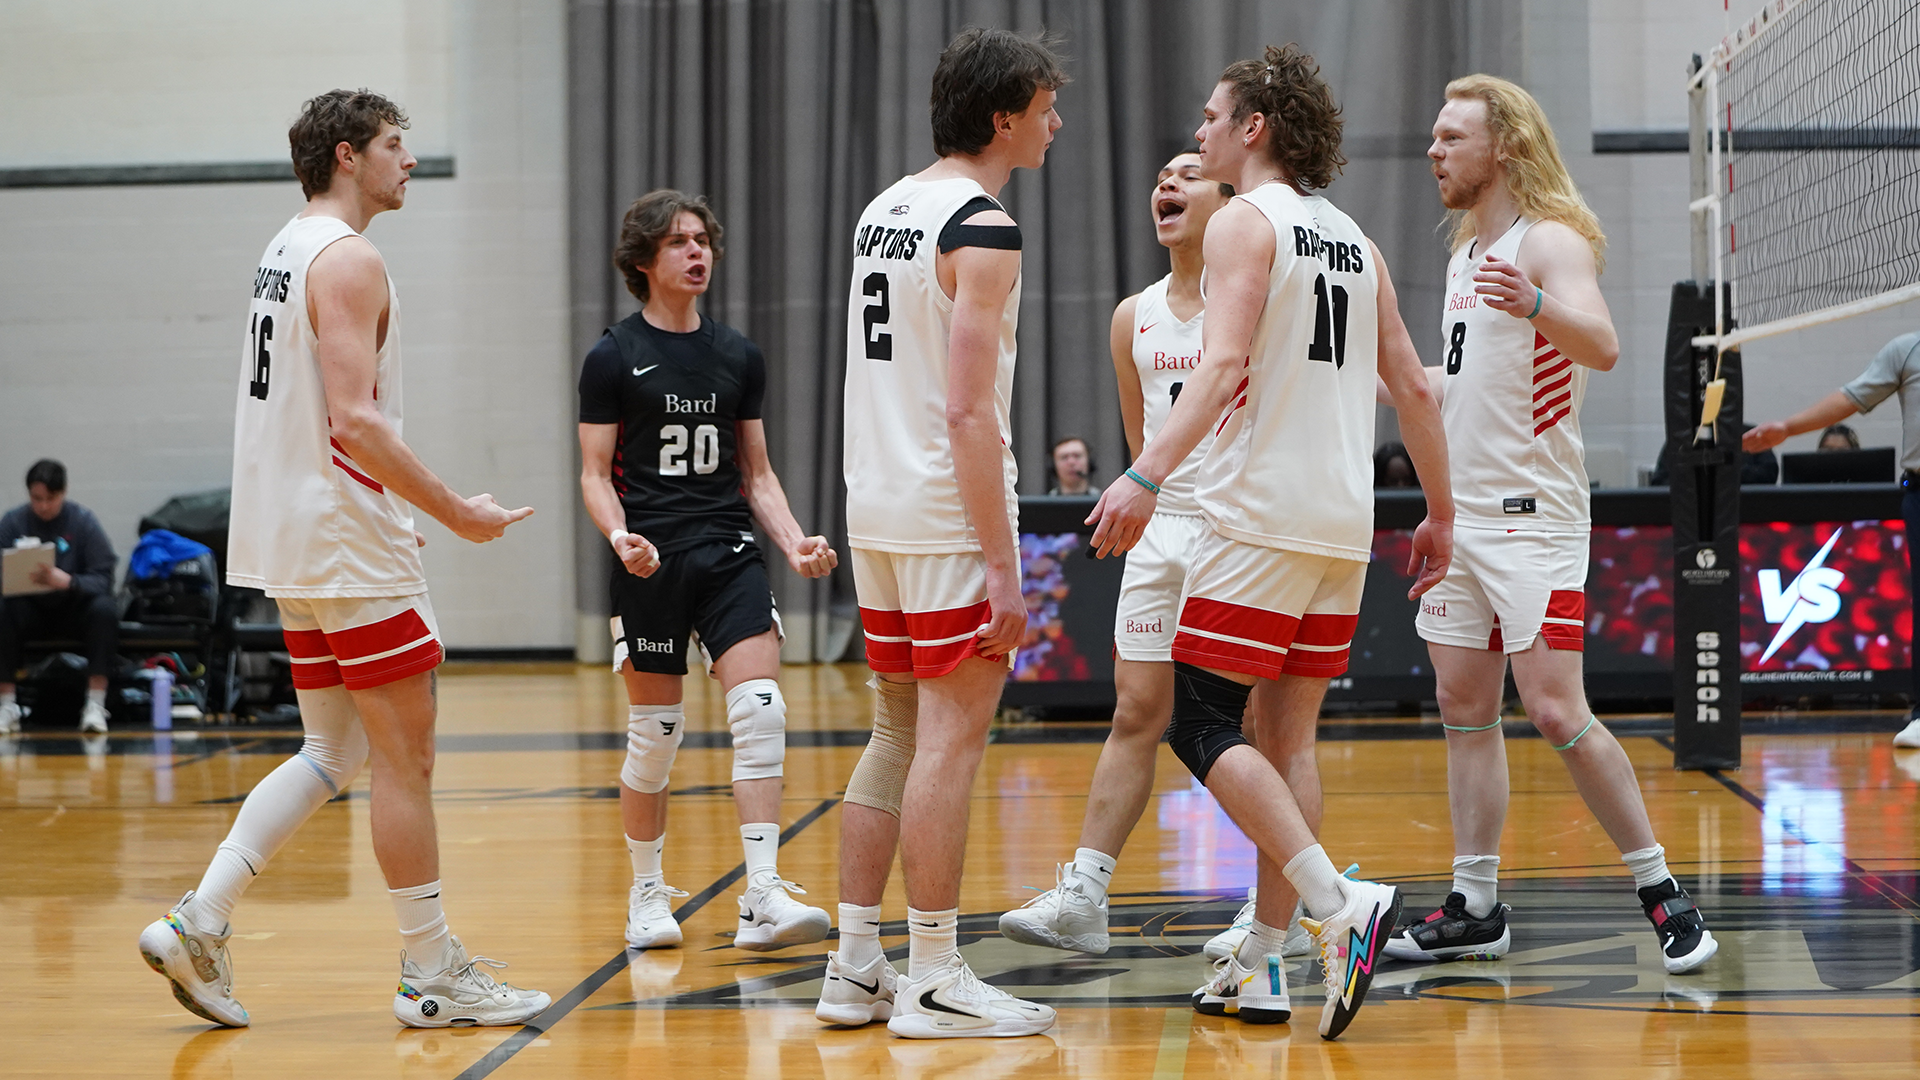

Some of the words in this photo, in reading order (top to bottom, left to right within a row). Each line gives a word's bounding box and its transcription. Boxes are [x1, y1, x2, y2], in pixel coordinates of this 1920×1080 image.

[863, 272, 892, 361] 2
[1308, 272, 1349, 371] 10
[1448, 292, 1478, 311] Bard
[250, 312, 274, 401] 16
[1153, 349, 1202, 371] Bard
[1447, 321, 1466, 376] 8
[664, 392, 717, 414] Bard
[659, 424, 720, 477] 20
[1757, 566, 1845, 624] VS
[636, 637, 674, 654] Bard
[1126, 618, 1162, 633] Bard
